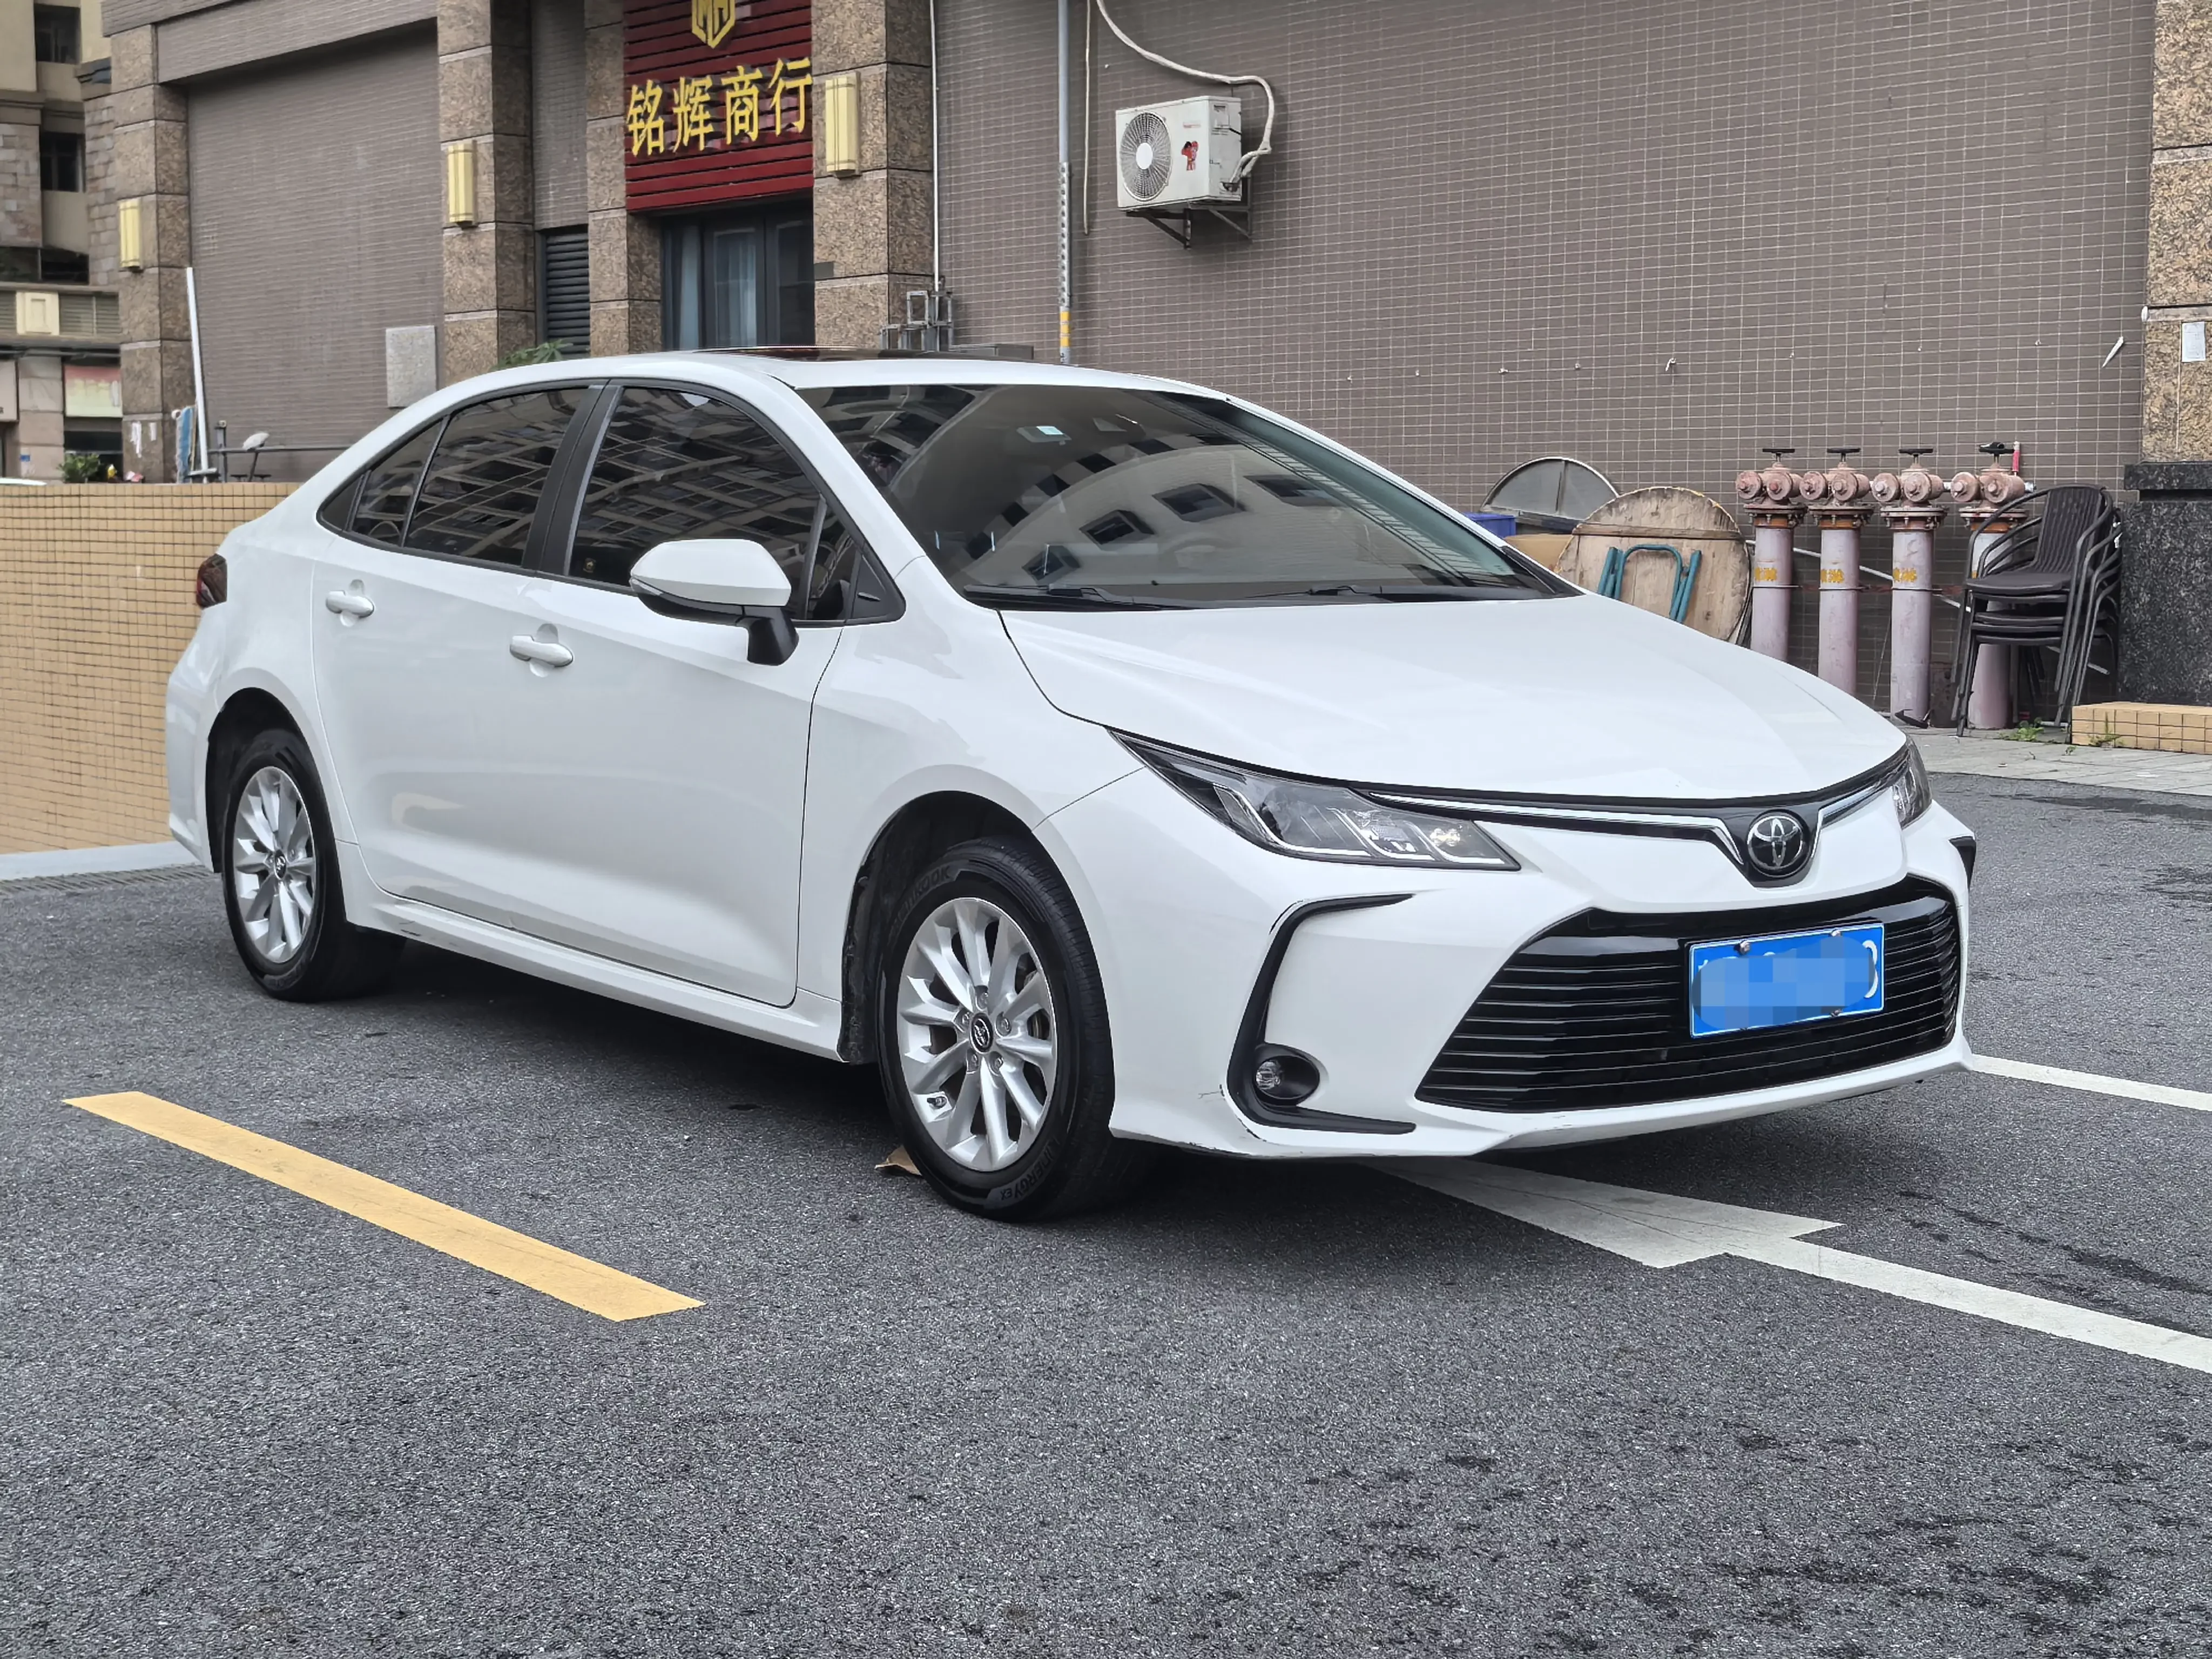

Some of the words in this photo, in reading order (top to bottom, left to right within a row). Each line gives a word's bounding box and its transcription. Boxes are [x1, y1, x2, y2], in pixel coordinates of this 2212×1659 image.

[625, 57, 813, 157] 铭辉商行
[1000, 1188, 1013, 1201] EX
